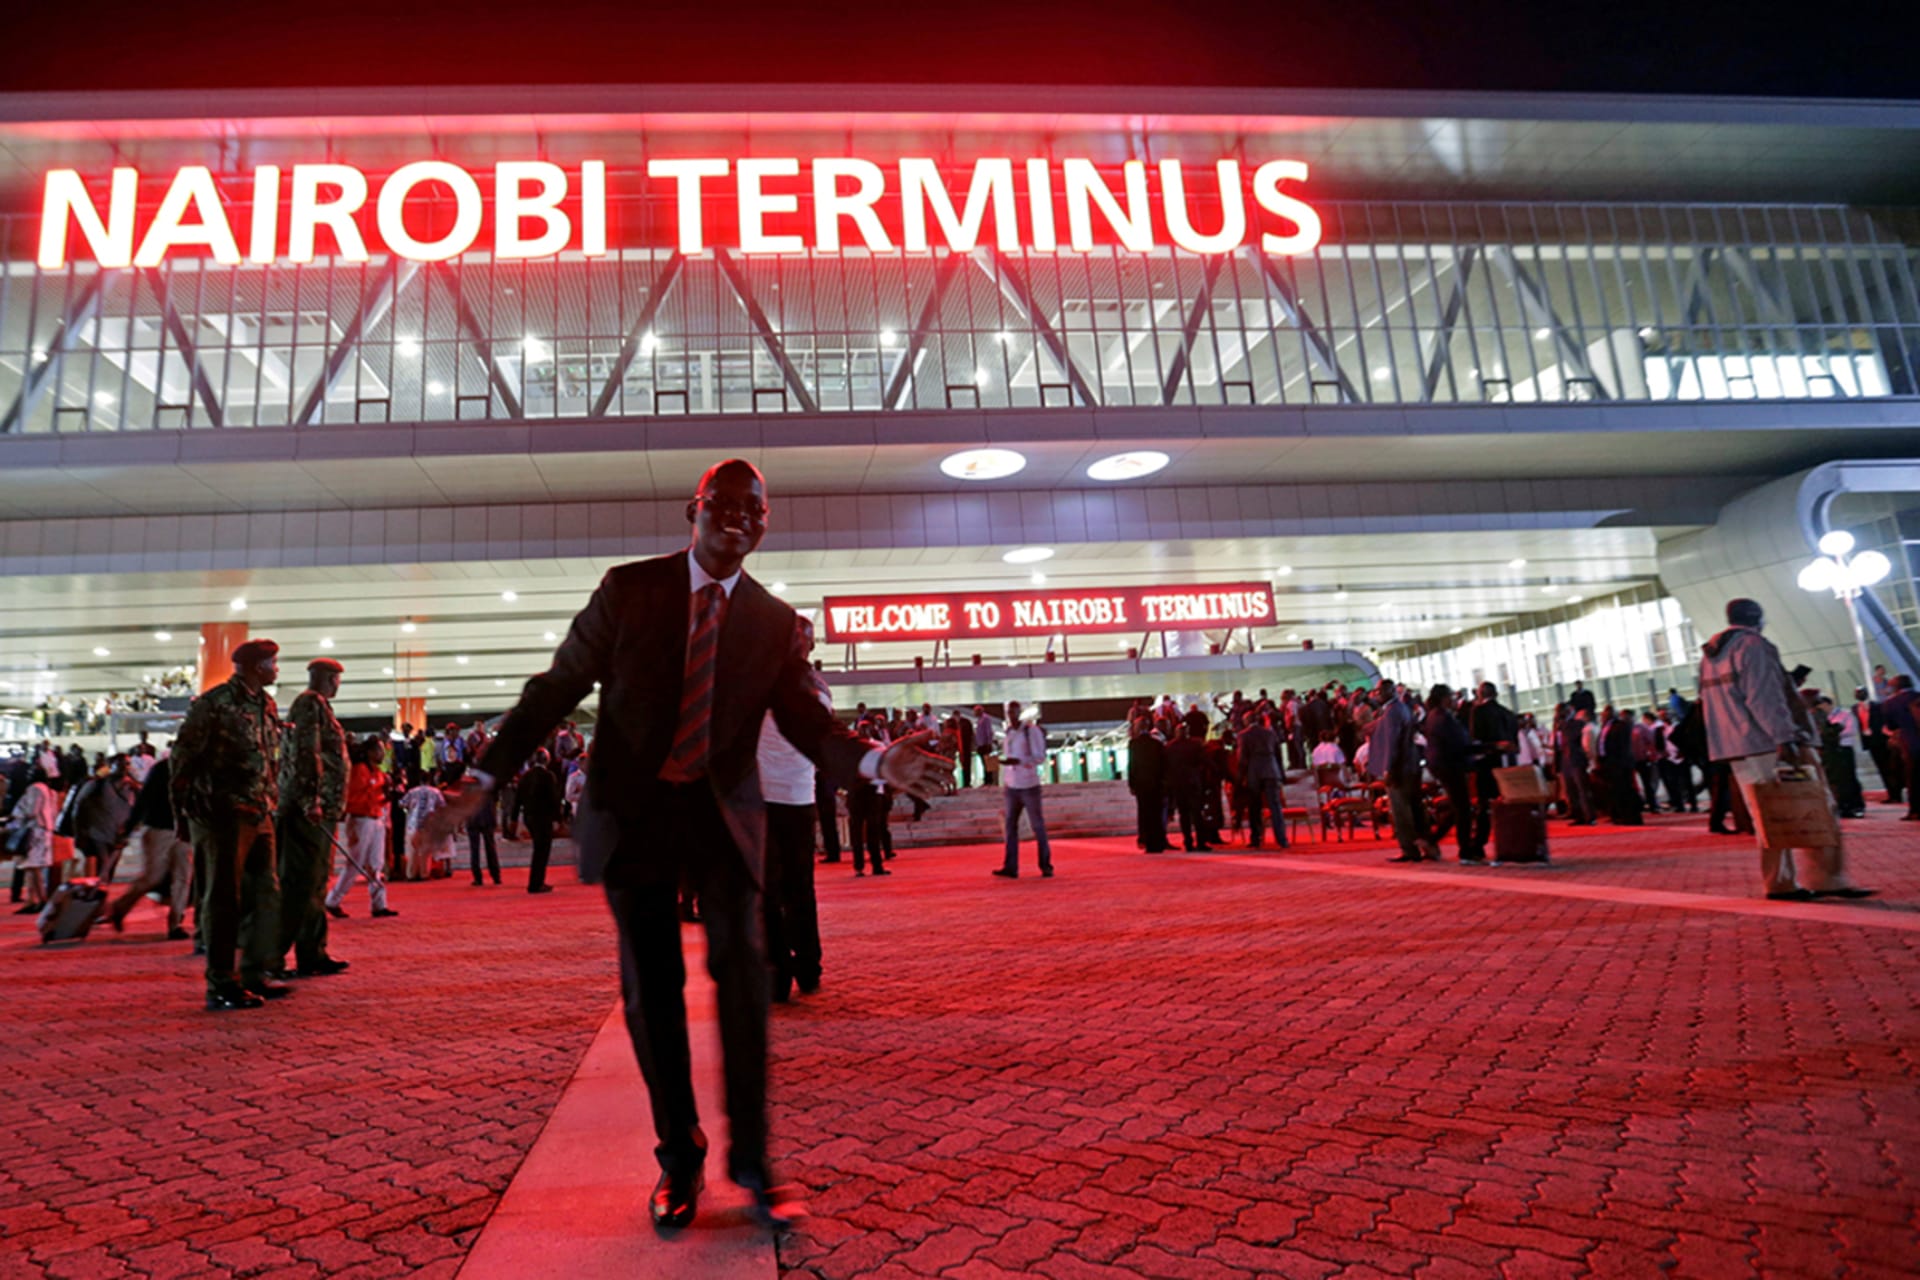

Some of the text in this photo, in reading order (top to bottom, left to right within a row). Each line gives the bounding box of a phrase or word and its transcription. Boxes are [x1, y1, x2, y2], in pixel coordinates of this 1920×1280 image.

[37, 157, 1322, 269] NAIROBI TERMINUS
[829, 591, 1270, 634] WELCOME TO NAIROBI TERMINUS
